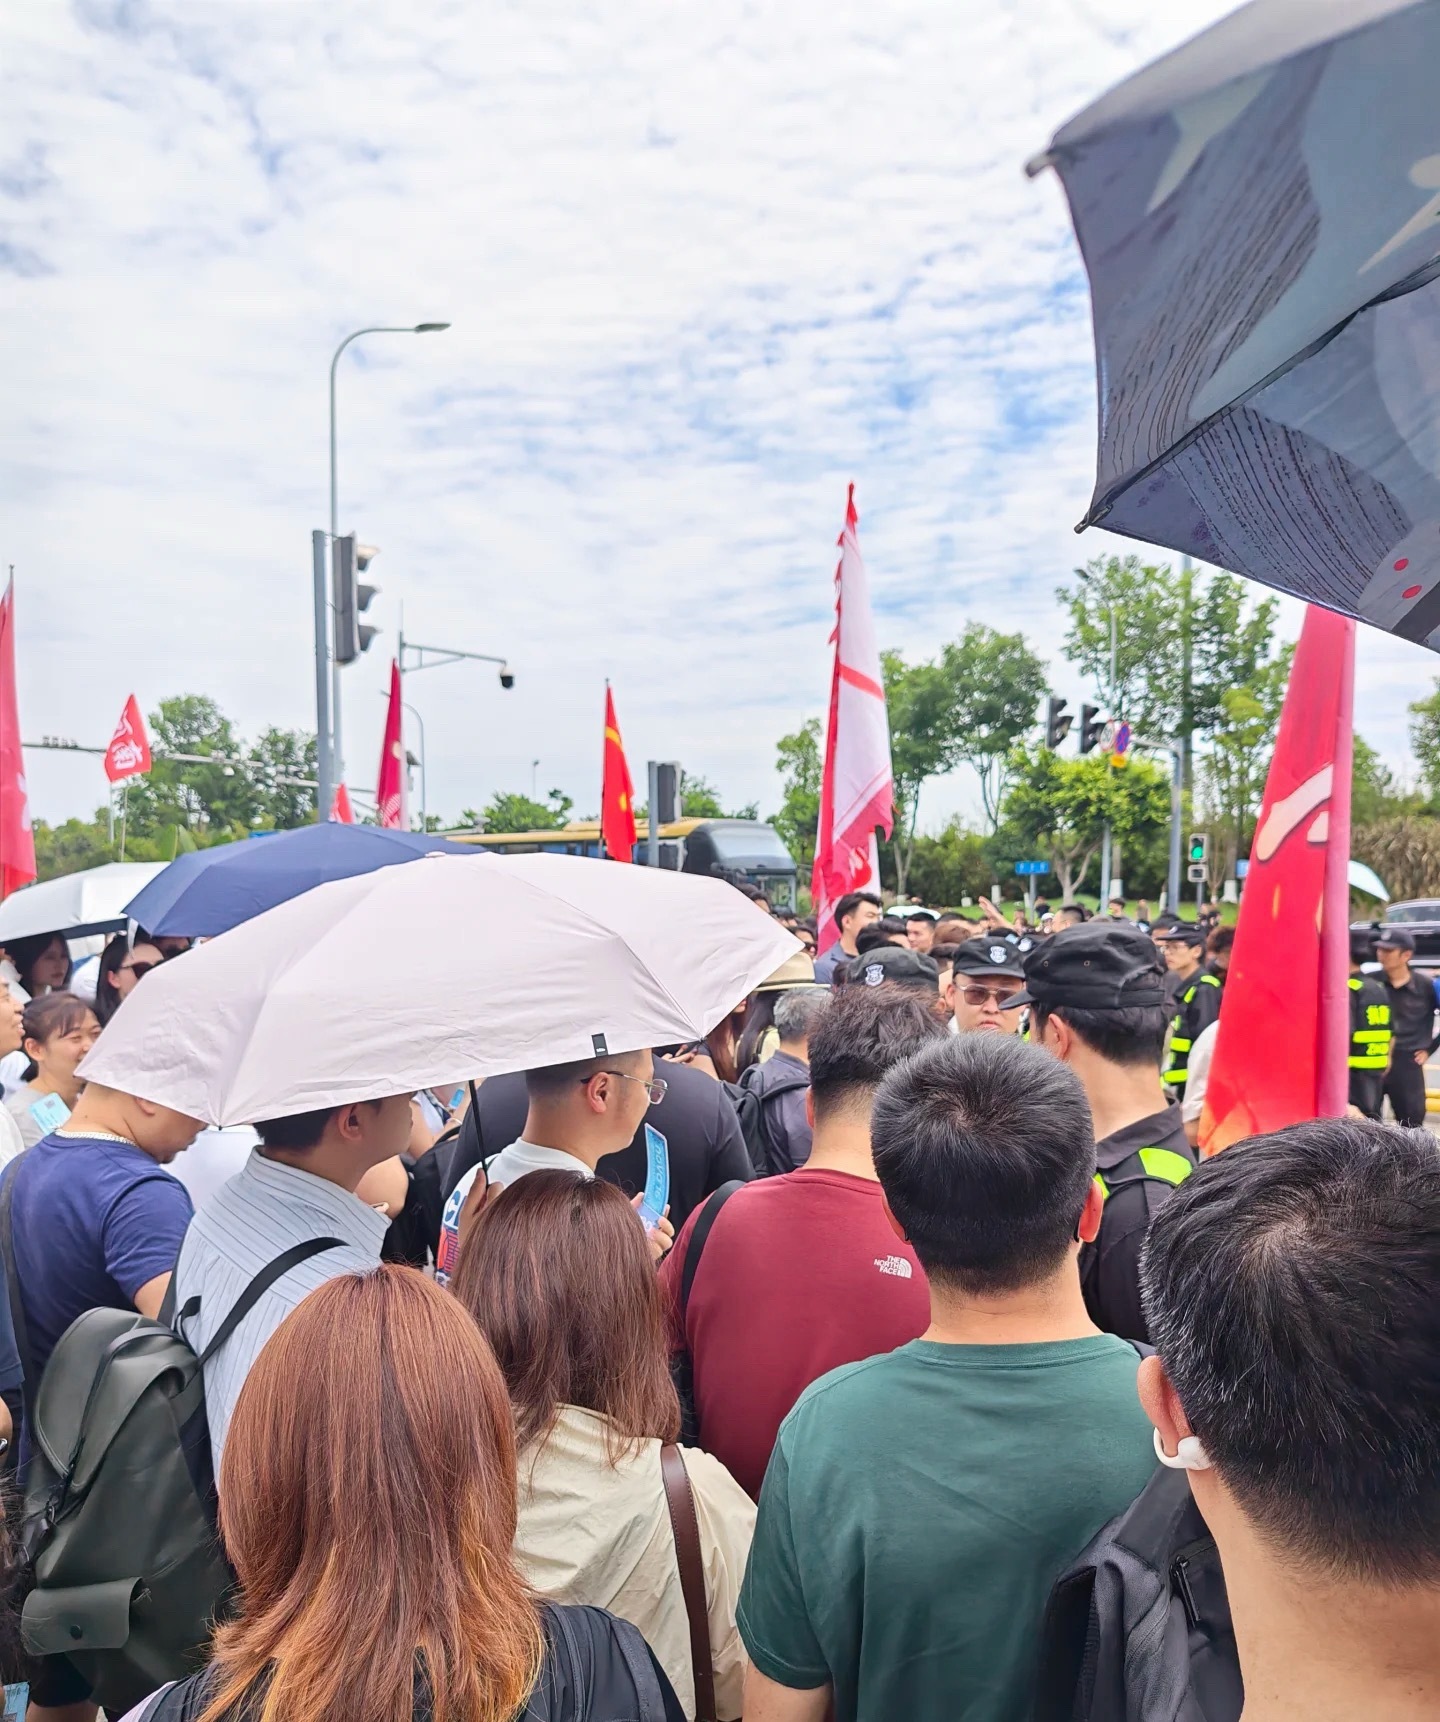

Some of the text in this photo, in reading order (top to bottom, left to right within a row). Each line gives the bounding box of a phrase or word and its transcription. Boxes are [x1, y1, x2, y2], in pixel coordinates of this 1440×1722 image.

[874, 1258, 900, 1269] NORTH
[887, 1255, 900, 1263] THE
[879, 1265, 898, 1276] FACE
